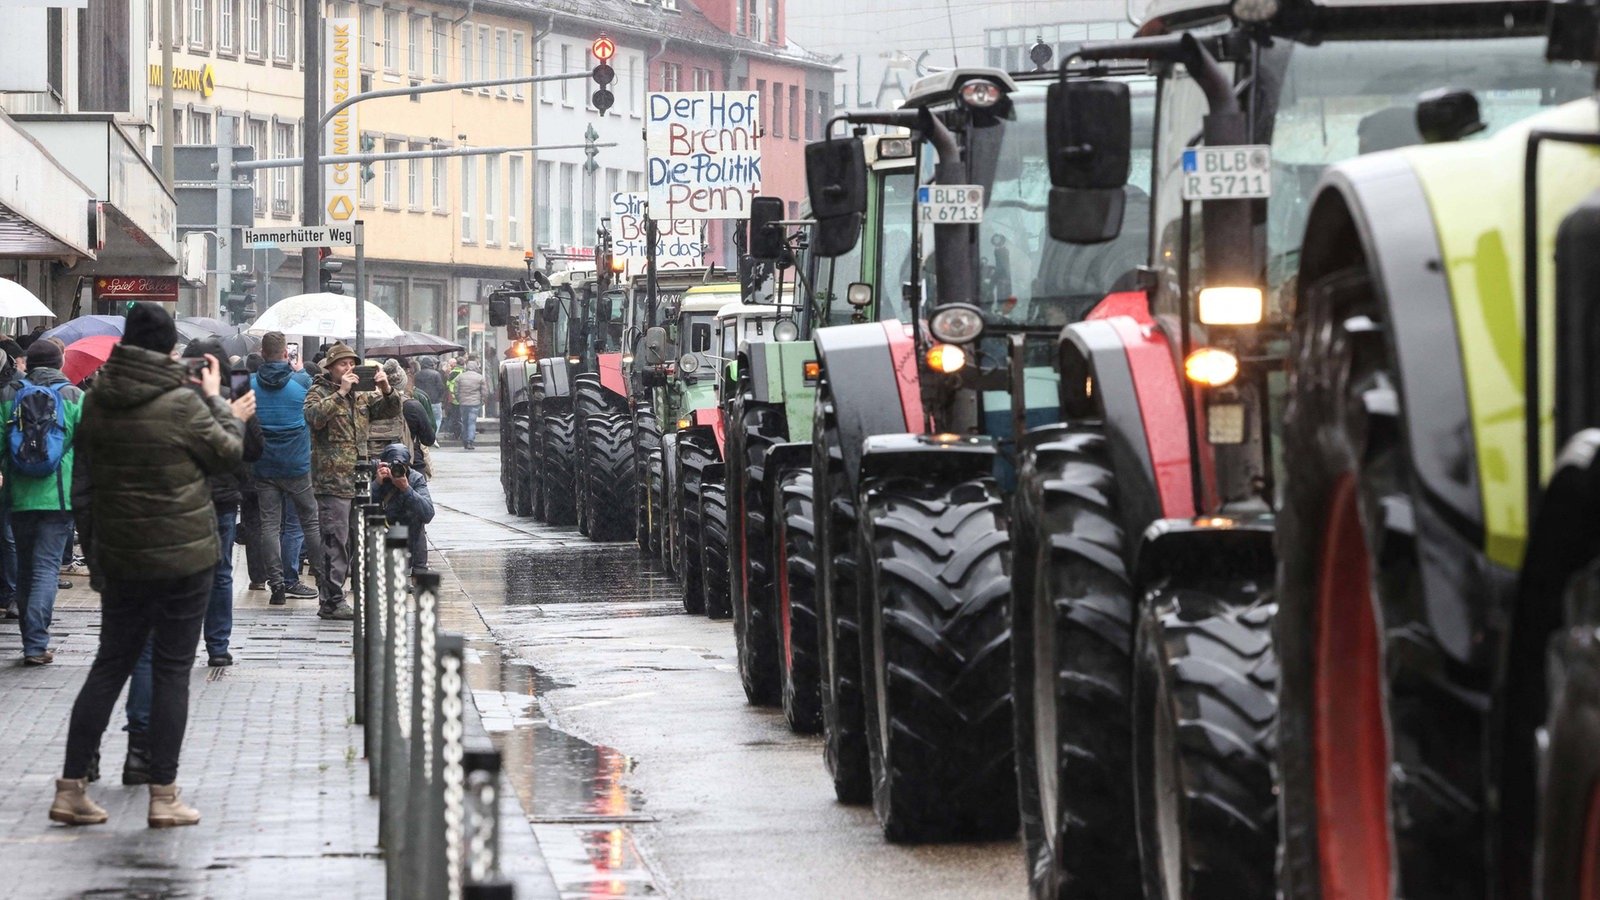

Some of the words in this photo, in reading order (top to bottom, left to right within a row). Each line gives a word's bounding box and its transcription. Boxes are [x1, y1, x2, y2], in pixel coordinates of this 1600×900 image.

[148, 64, 202, 92] MZBANK
[650, 94, 704, 121] Der
[710, 92, 757, 127] Hof
[669, 120, 761, 156] Brennt
[649, 157, 691, 186] Die
[690, 153, 761, 184] Politik
[1205, 153, 1247, 172] BLB
[1188, 176, 1201, 195] R
[1210, 175, 1264, 194] 5711
[613, 192, 648, 215] Stir
[935, 189, 966, 204] BLB
[922, 206, 932, 220] R
[938, 206, 978, 220] 6713
[245, 228, 324, 243] Hammerhütter
[329, 228, 352, 244] Weg
[669, 237, 701, 258] das
[107, 279, 135, 294] Spiel
